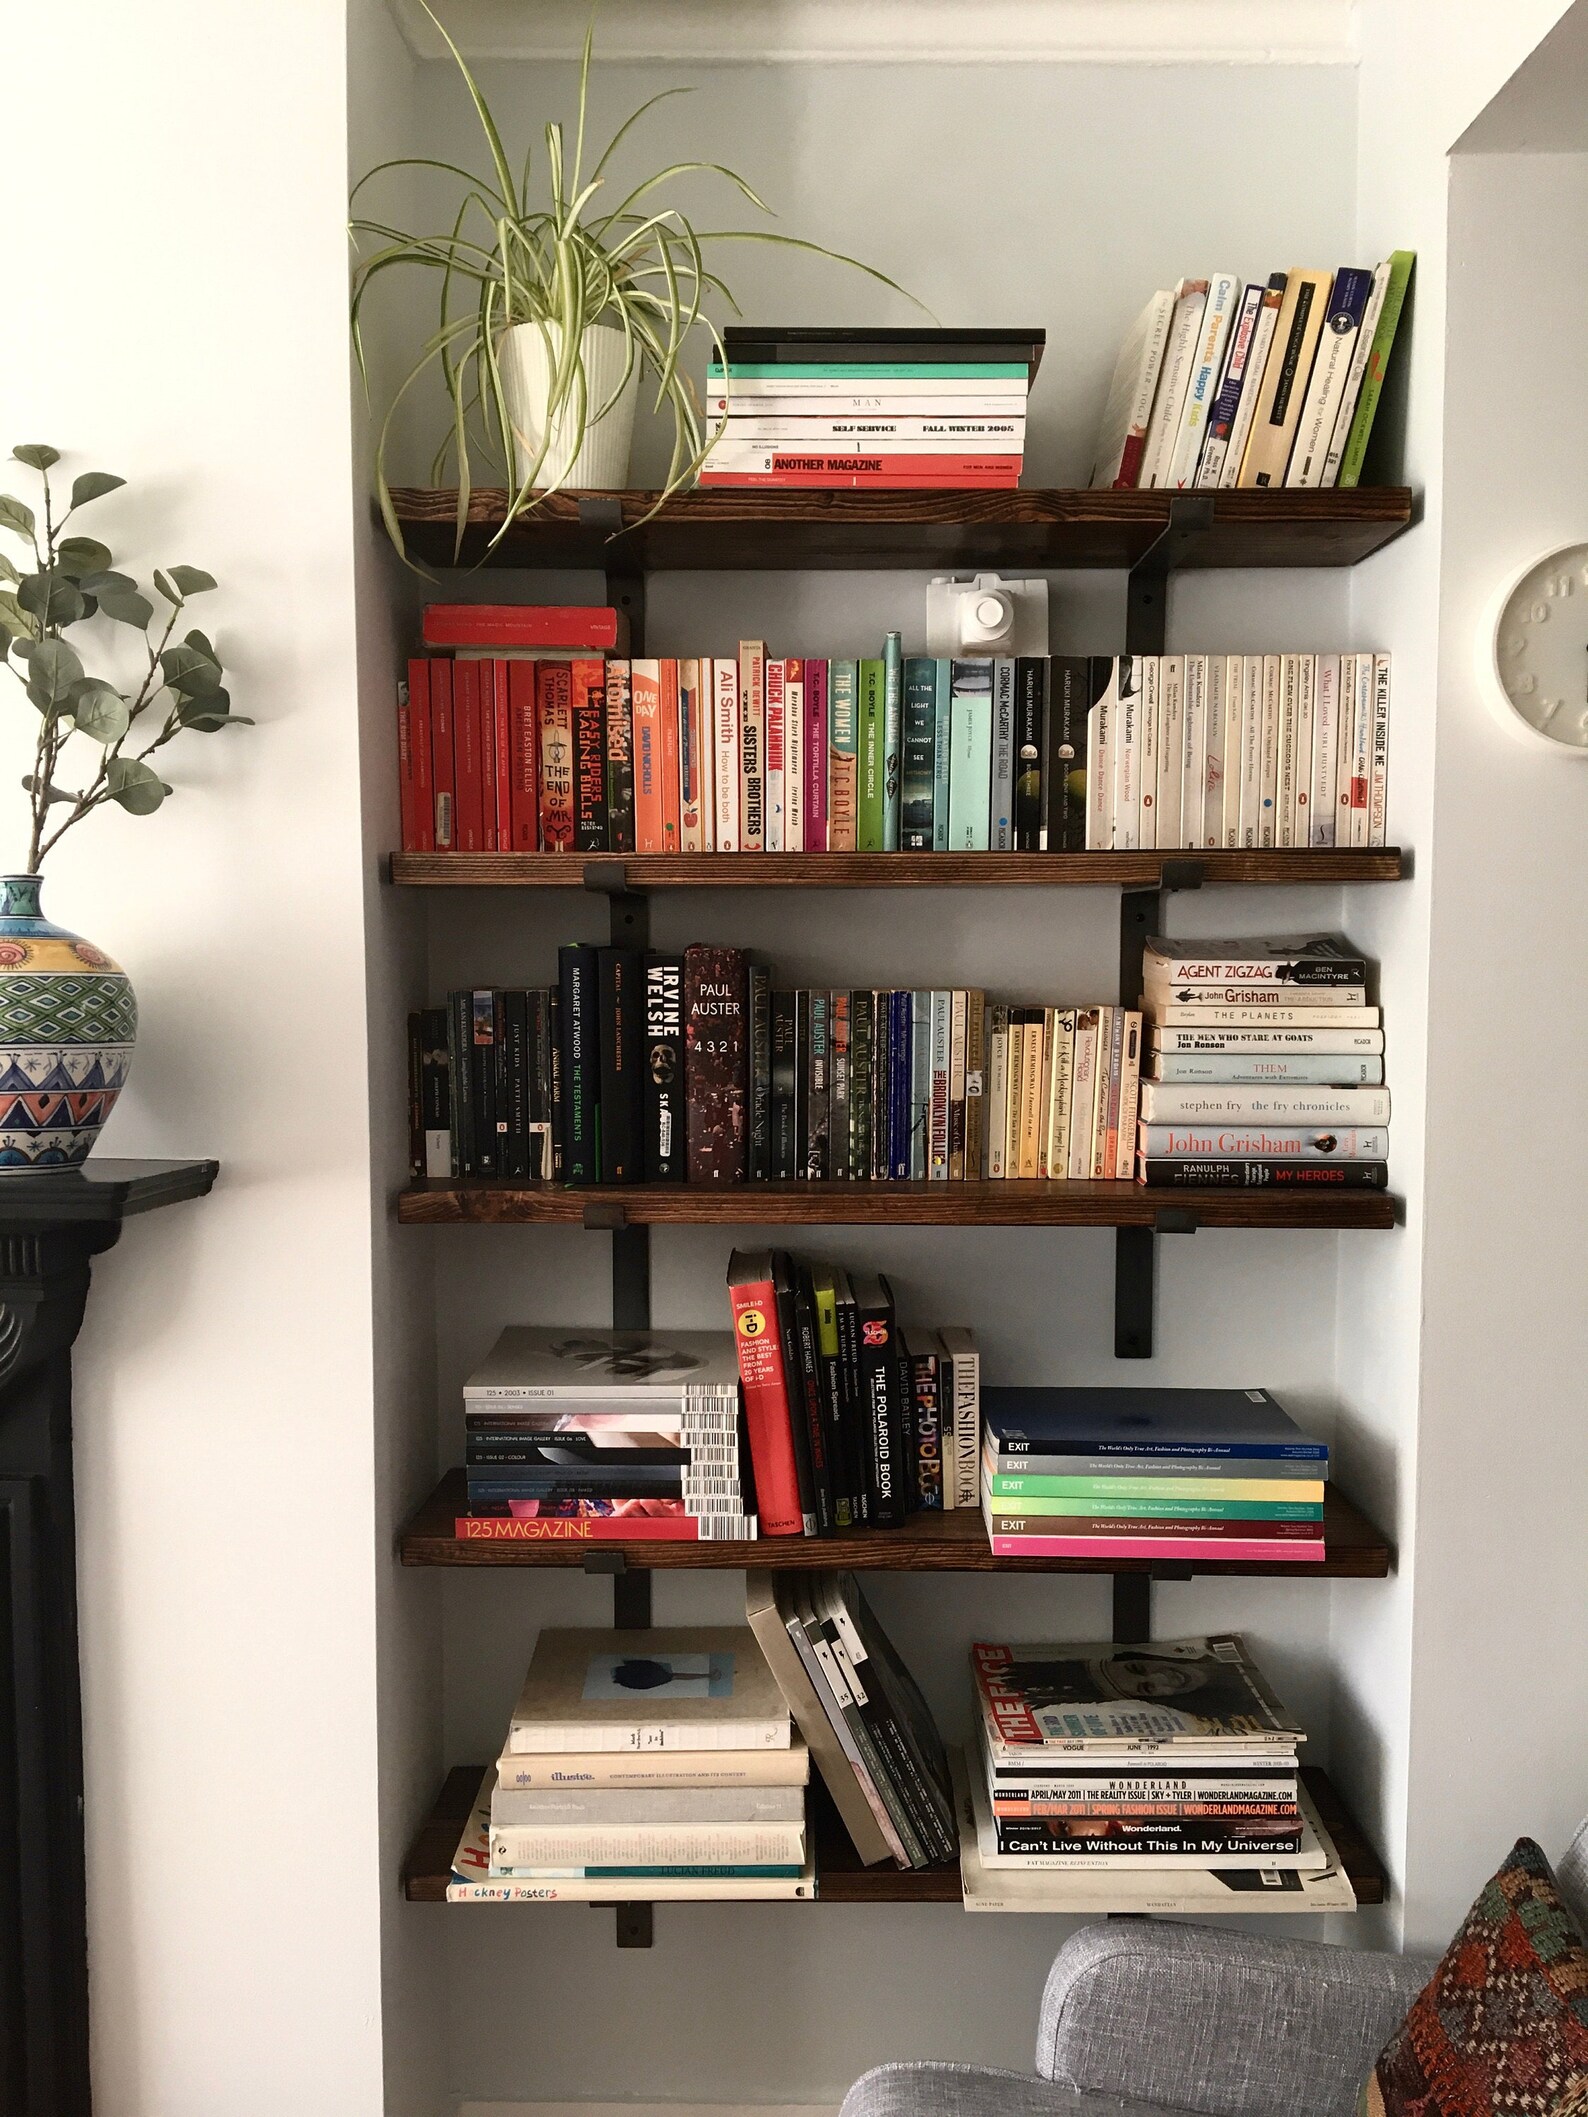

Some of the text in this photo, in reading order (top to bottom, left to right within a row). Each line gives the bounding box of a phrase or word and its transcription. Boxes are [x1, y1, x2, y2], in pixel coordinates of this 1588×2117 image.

[1215, 280, 1230, 311] Calm
[1246, 303, 1257, 315] The
[1194, 367, 1211, 401] Happy
[1308, 337, 1342, 452] Natural Healing Women
[853, 399, 882, 407] MAN
[774, 459, 882, 471] ANOTHER MAGAZINE
[544, 677, 555, 725] THOMAS
[556, 672, 568, 729] SCARLETT
[634, 690, 657, 704] ONE
[835, 673, 851, 743] THE WOMEN
[607, 663, 628, 761] Atomised
[636, 704, 657, 718] DAY
[768, 665, 783, 771] CHUCK PALAHNIUK
[999, 667, 1010, 779] CORMAC McCARTHY THE ROAD
[1125, 704, 1134, 744] Murakami
[1099, 705, 1108, 745] Murakami
[524, 706, 532, 792] BRET EASTON ELLIS
[589, 710, 602, 801] EASY RIDERS
[721, 671, 733, 823] Ali Smith How to be both
[1373, 668, 1388, 828] THE KILLER INSIDE ME JIM THOMPSON
[579, 710, 592, 819] RAGING BULLS
[642, 727, 651, 794] DAVID NICHOLLS
[743, 726, 761, 835] SISTERS BROTHERS
[1178, 965, 1272, 978] AGENT ZIGZAG
[572, 967, 581, 1017] MARGARET
[648, 966, 663, 1036] WELSH
[664, 966, 679, 1036] IRVINE
[700, 984, 732, 997] PAUL
[1205, 989, 1279, 1003] John Grisham
[691, 1003, 740, 1015] AUSTER
[573, 1020, 581, 1058] ATWOOD
[1177, 1041, 1225, 1049] Jon Ronson
[1180, 1101, 1350, 1112] stephen fry the fry chronicles
[1166, 1133, 1300, 1154] John Grisham
[1183, 1165, 1229, 1173] RANULPH
[1276, 1170, 1293, 1181] MY
[1296, 1170, 1345, 1181] HEROES
[875, 1366, 891, 1498] THE POLAROID BOOK
[1008, 1443, 1030, 1451] EXIT
[1007, 1461, 1028, 1469] EXIT
[1002, 1481, 1023, 1490] EXIT
[495, 1522, 593, 1537] MAGAZINE
[768, 1520, 795, 1528] TASCHEN
[1001, 1520, 1026, 1530] EXIT
[978, 1648, 1035, 1738] THE FACE
[1031, 1790, 1066, 1800] APRIL/MAY
[1068, 1791, 1081, 1799] 2011
[1088, 1791, 1099, 1799] THE
[1101, 1791, 1127, 1799] REALITY
[1128, 1791, 1145, 1799] ISSUE
[1198, 1791, 1292, 1800] WONDERLANDMAGAZINE.COM
[1109, 1781, 1187, 1790] WONDERLAND
[1052, 1840, 1082, 1851] Live
[1086, 1840, 1144, 1851] Without
[1147, 1841, 1178, 1851] This
[1182, 1840, 1196, 1851] In
[1201, 1840, 1223, 1853] My
[1227, 1840, 1294, 1851] Universe
[515, 1888, 557, 1898] Posters
